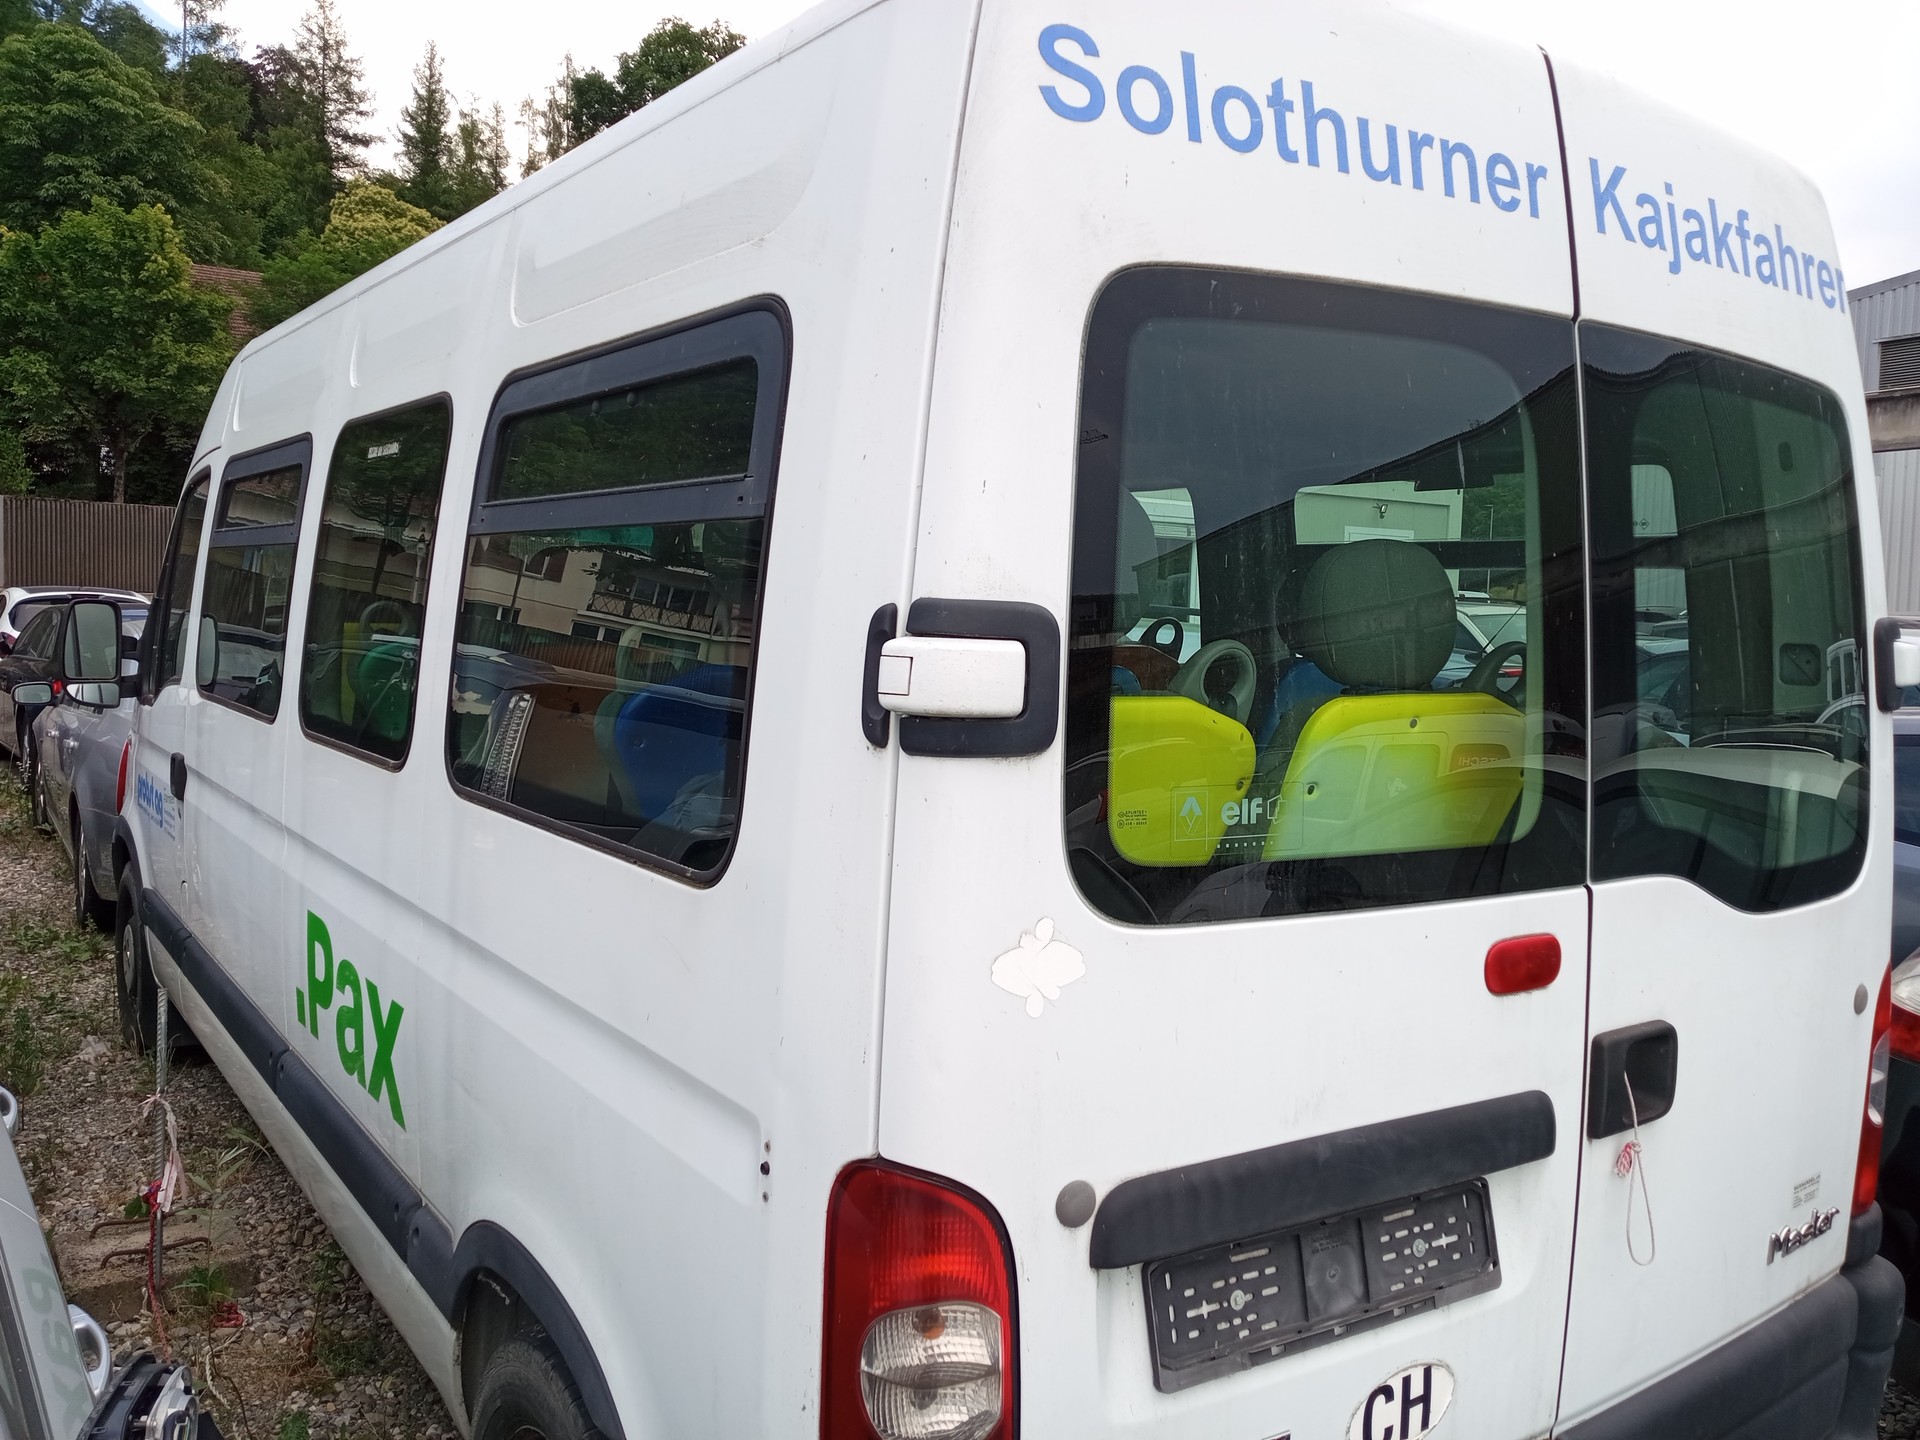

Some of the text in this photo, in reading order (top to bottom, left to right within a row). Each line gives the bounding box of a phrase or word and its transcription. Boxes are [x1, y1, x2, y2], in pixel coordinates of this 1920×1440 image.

[1037, 23, 1845, 315] Solothurner Kajakfahrer
[1221, 798, 1262, 826] elf
[1766, 1207, 1840, 1266] Master
[1363, 1365, 1432, 1440] CH
